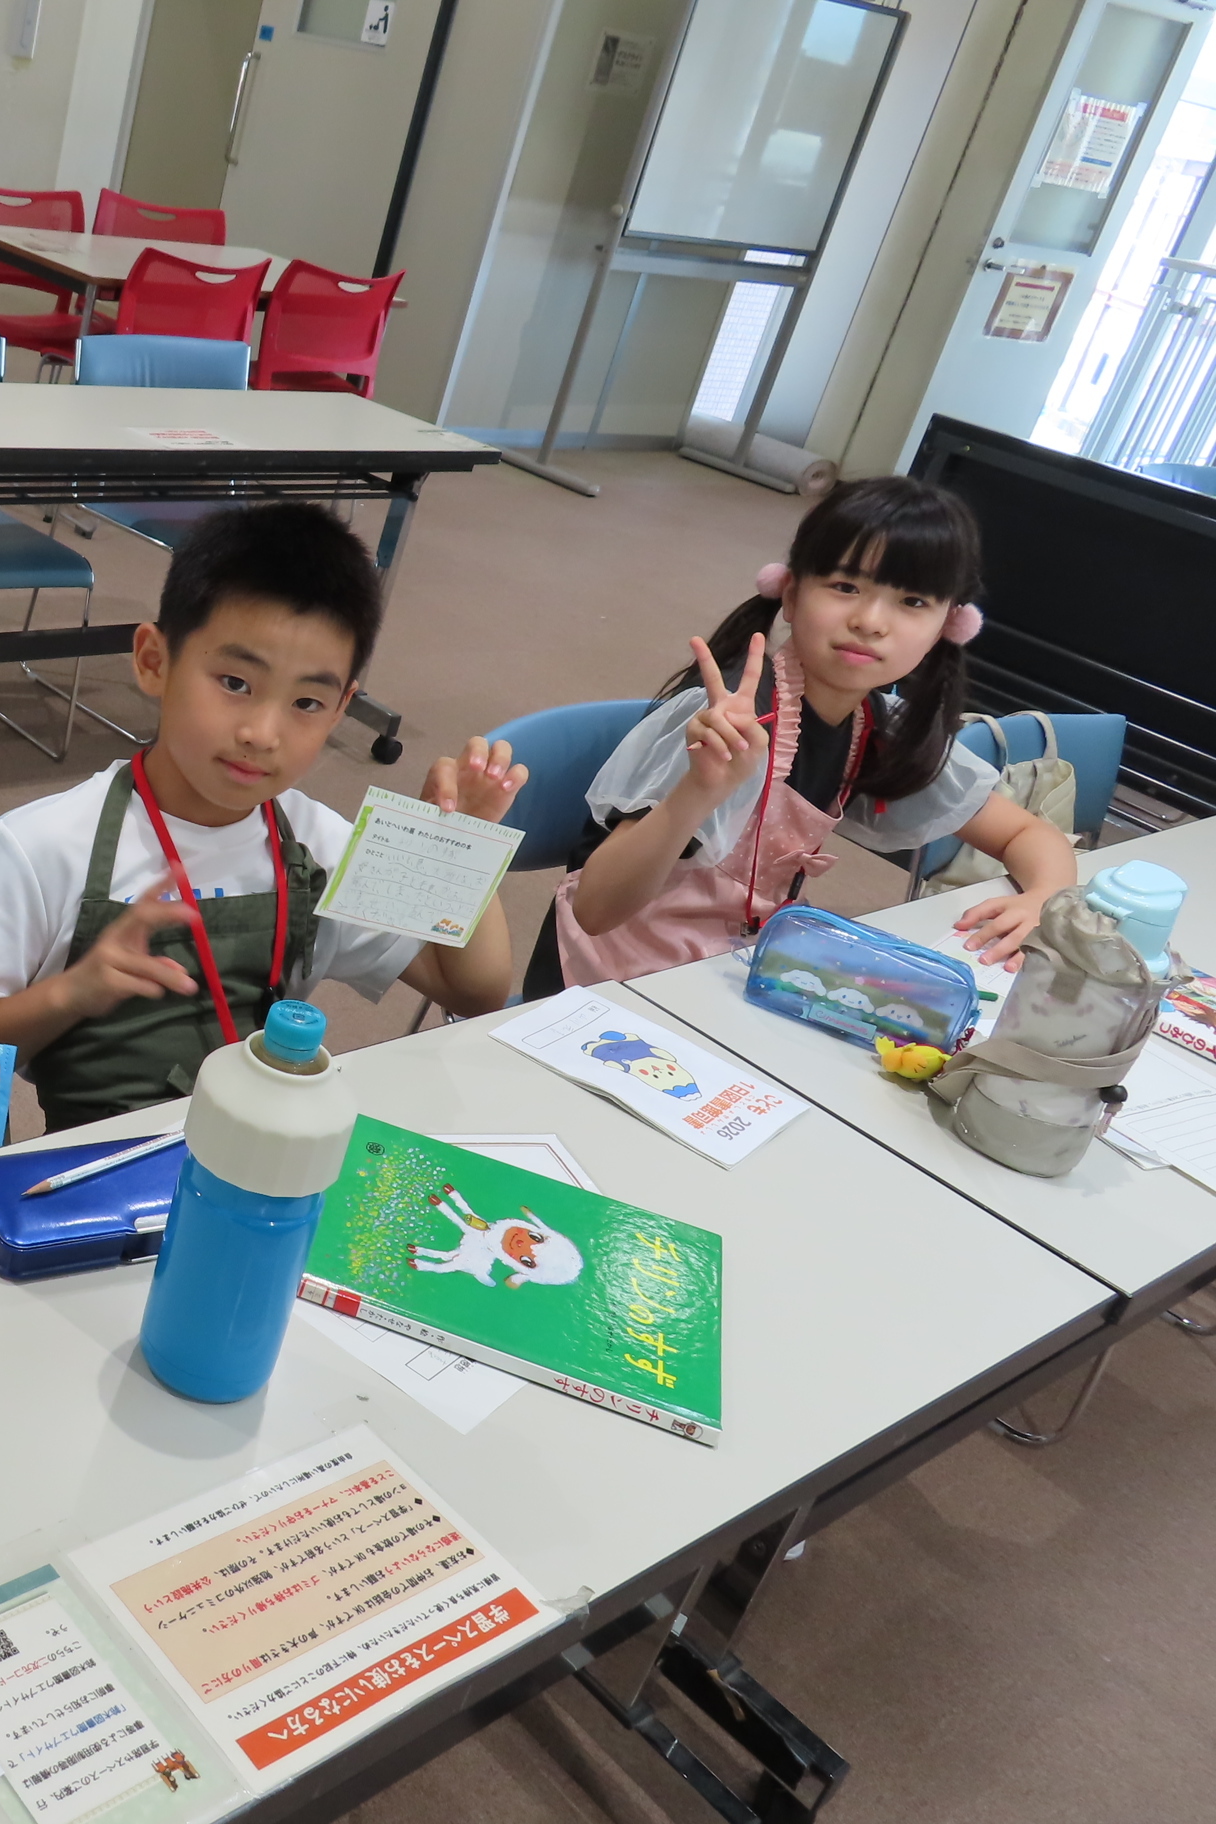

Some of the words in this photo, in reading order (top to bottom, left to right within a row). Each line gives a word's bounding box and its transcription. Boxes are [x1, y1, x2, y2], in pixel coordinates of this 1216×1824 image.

[364, 848, 384, 858] ひとこと
[682, 1081, 755, 1130] 1日図書館司書
[746, 1094, 783, 1114] こども
[716, 1115, 751, 1141] 2026
[624, 1232, 683, 1389] チリンのすず
[553, 1376, 660, 1422] チリンのすず
[44, 1621, 68, 1639] うぞ。
[263, 1601, 513, 1747] 学習スペースをお使いになる方へ
[4, 1680, 114, 1743] 事前にお知らせしています。
